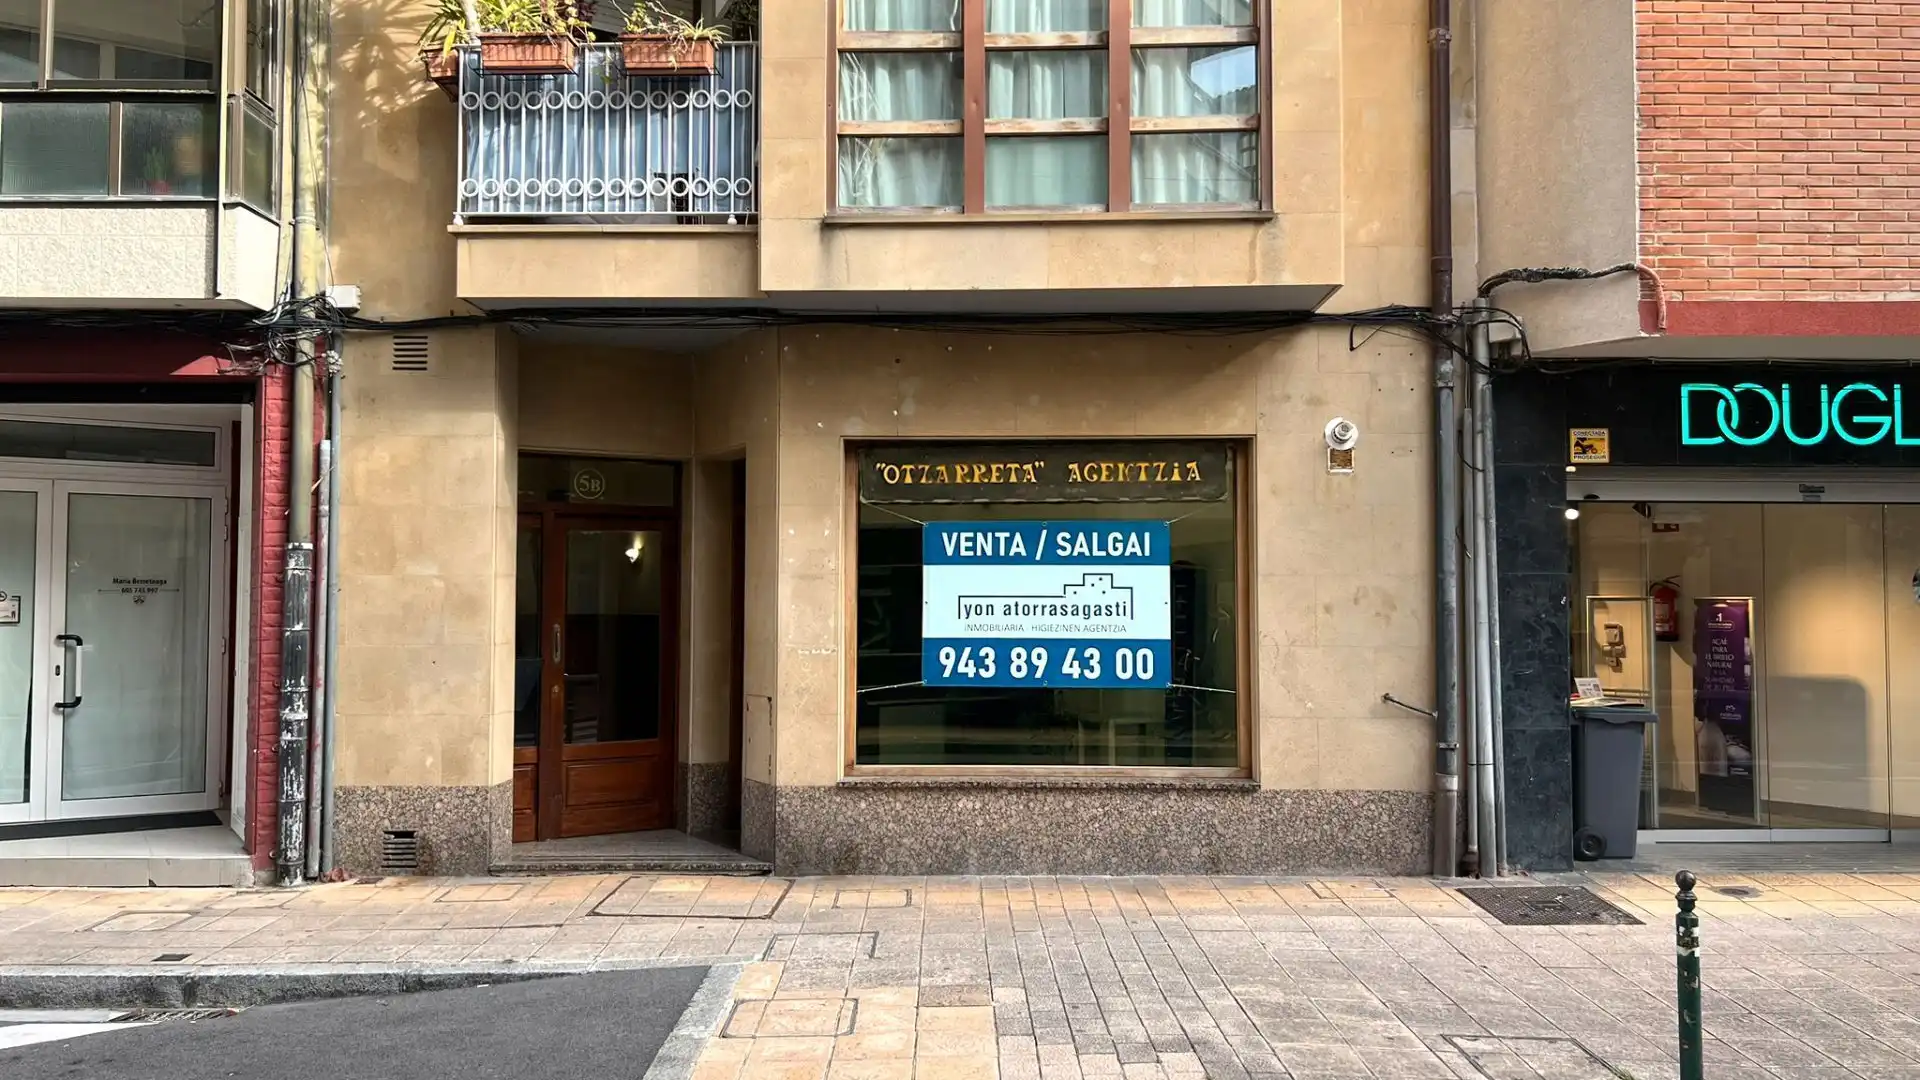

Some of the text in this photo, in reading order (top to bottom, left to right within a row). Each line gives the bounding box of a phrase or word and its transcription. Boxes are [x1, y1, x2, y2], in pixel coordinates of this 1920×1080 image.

[1681, 383, 1920, 446] DOUGL
[942, 529, 1150, 560] VENTA / SALGAI
[964, 601, 1127, 620] yon atorrasagasti
[964, 624, 1127, 633] INMOBILIARIA HIGIEZINEN AGENTZIA
[938, 646, 1154, 680] 943 89 43 00
